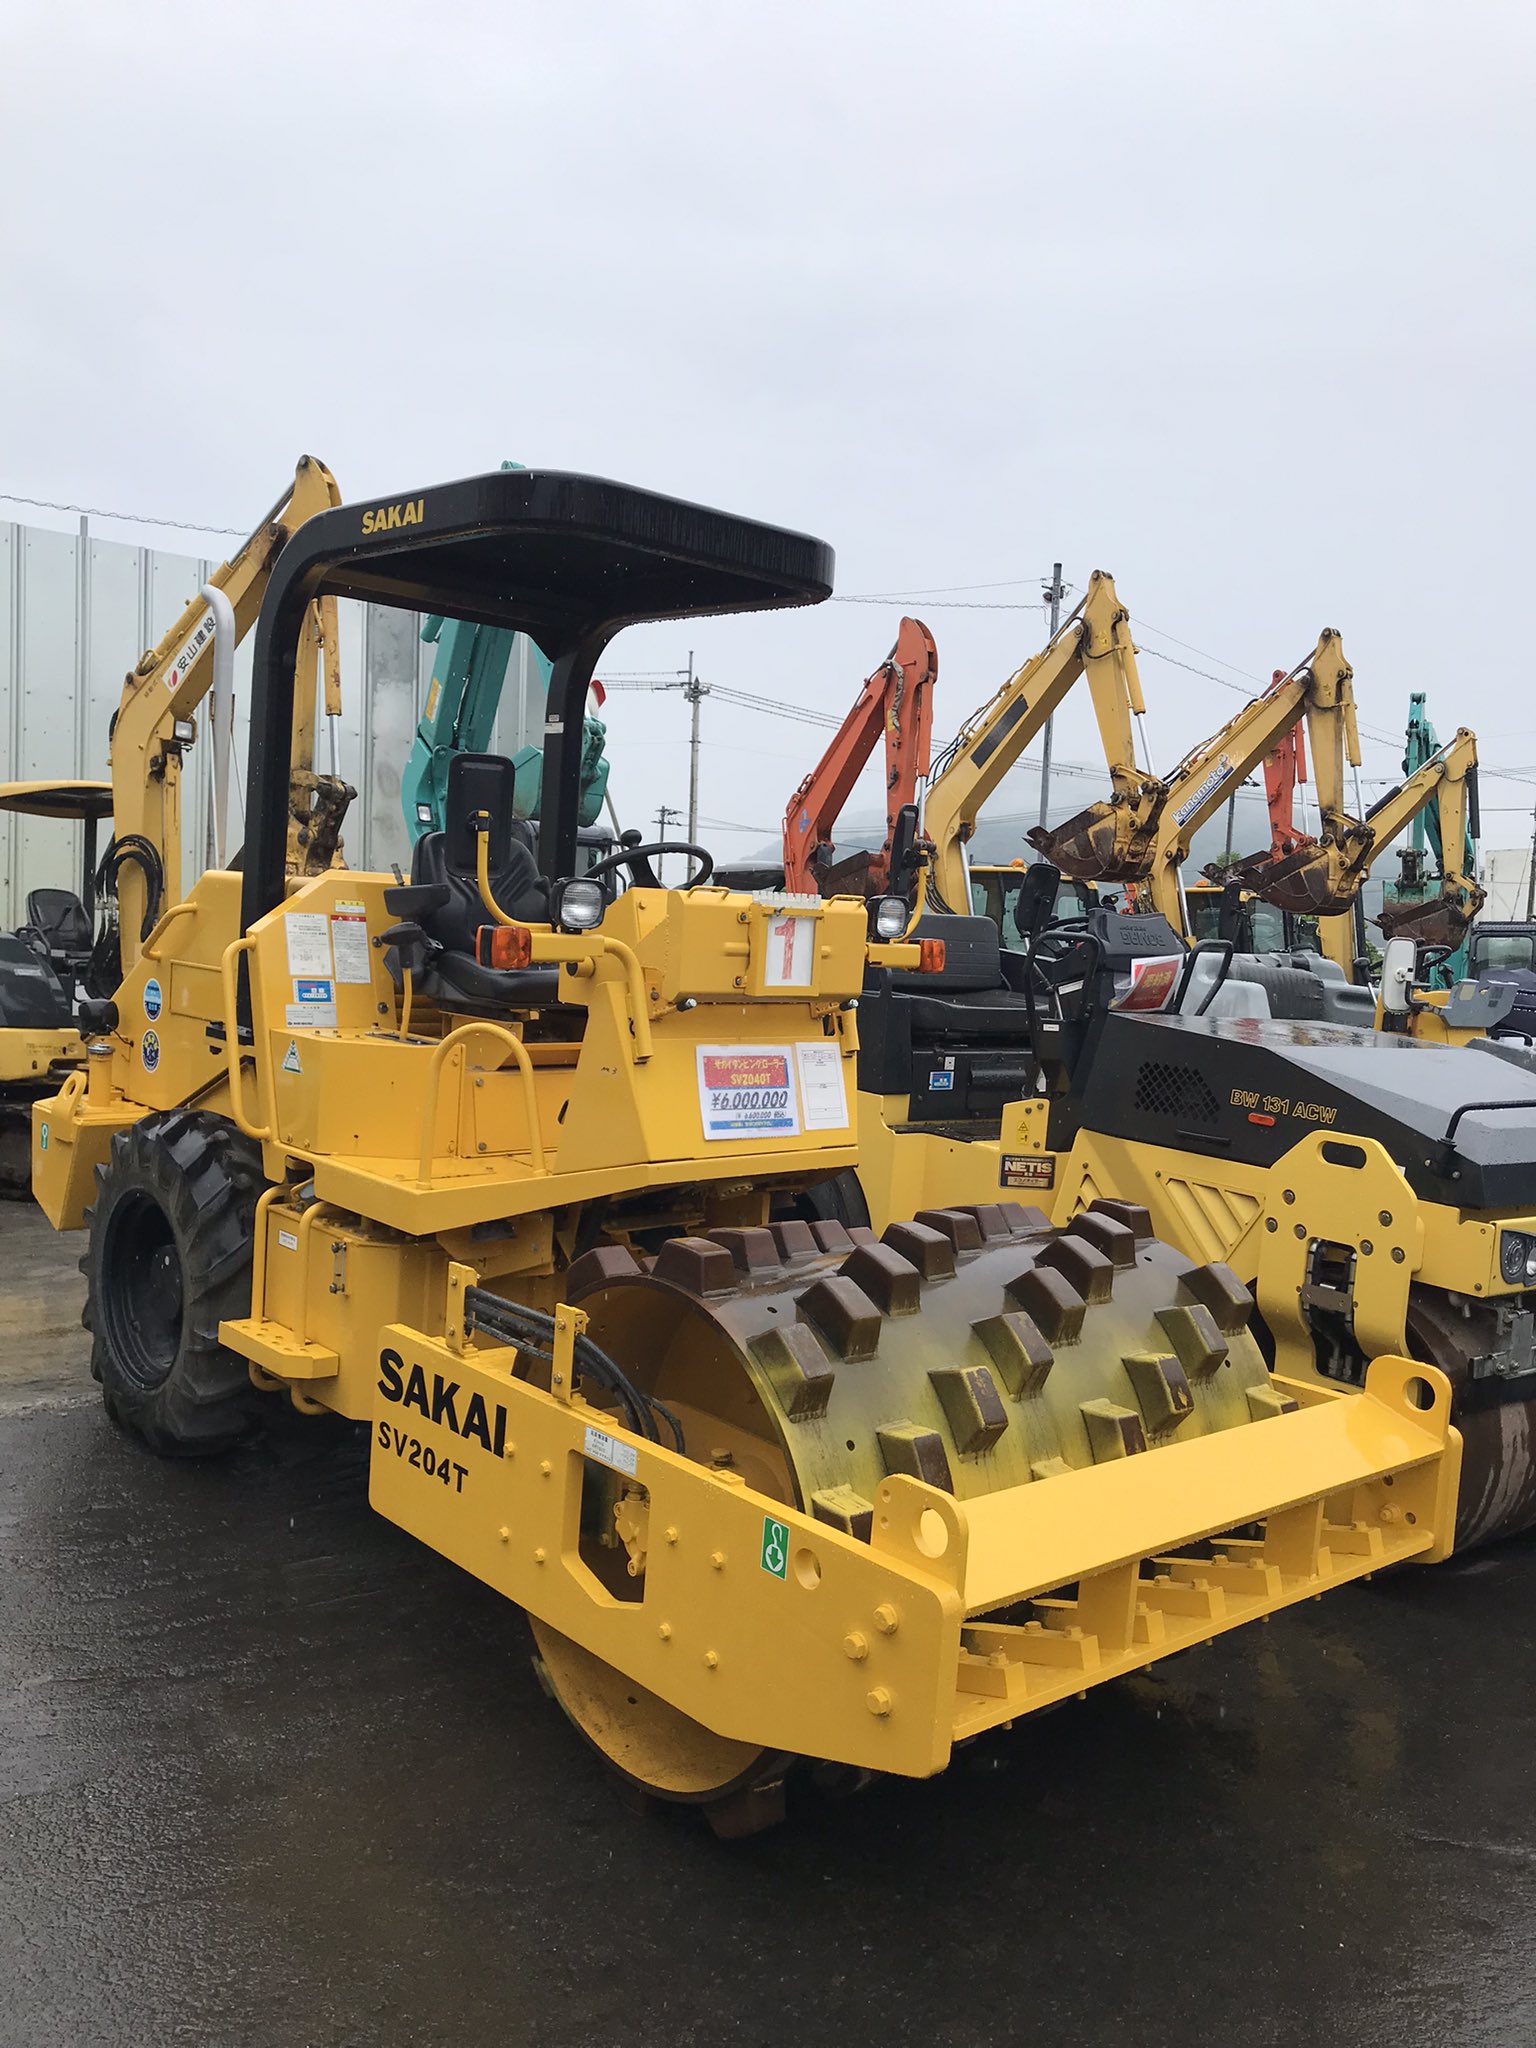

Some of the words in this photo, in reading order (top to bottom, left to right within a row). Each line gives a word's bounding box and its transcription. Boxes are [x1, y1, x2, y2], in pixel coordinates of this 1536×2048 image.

[361, 499, 424, 535] SAKAI
[177, 616, 217, 674] 安山建設
[1171, 764, 1226, 823] kanamoto
[775, 917, 796, 980] 1
[1230, 1088, 1260, 1109] BW
[1263, 1095, 1290, 1115] 131
[1292, 1101, 1338, 1124] ACW
[1004, 1160, 1053, 1174] NETIS
[377, 1348, 507, 1460] SAKAI
[378, 1421, 469, 1494] SV204T
